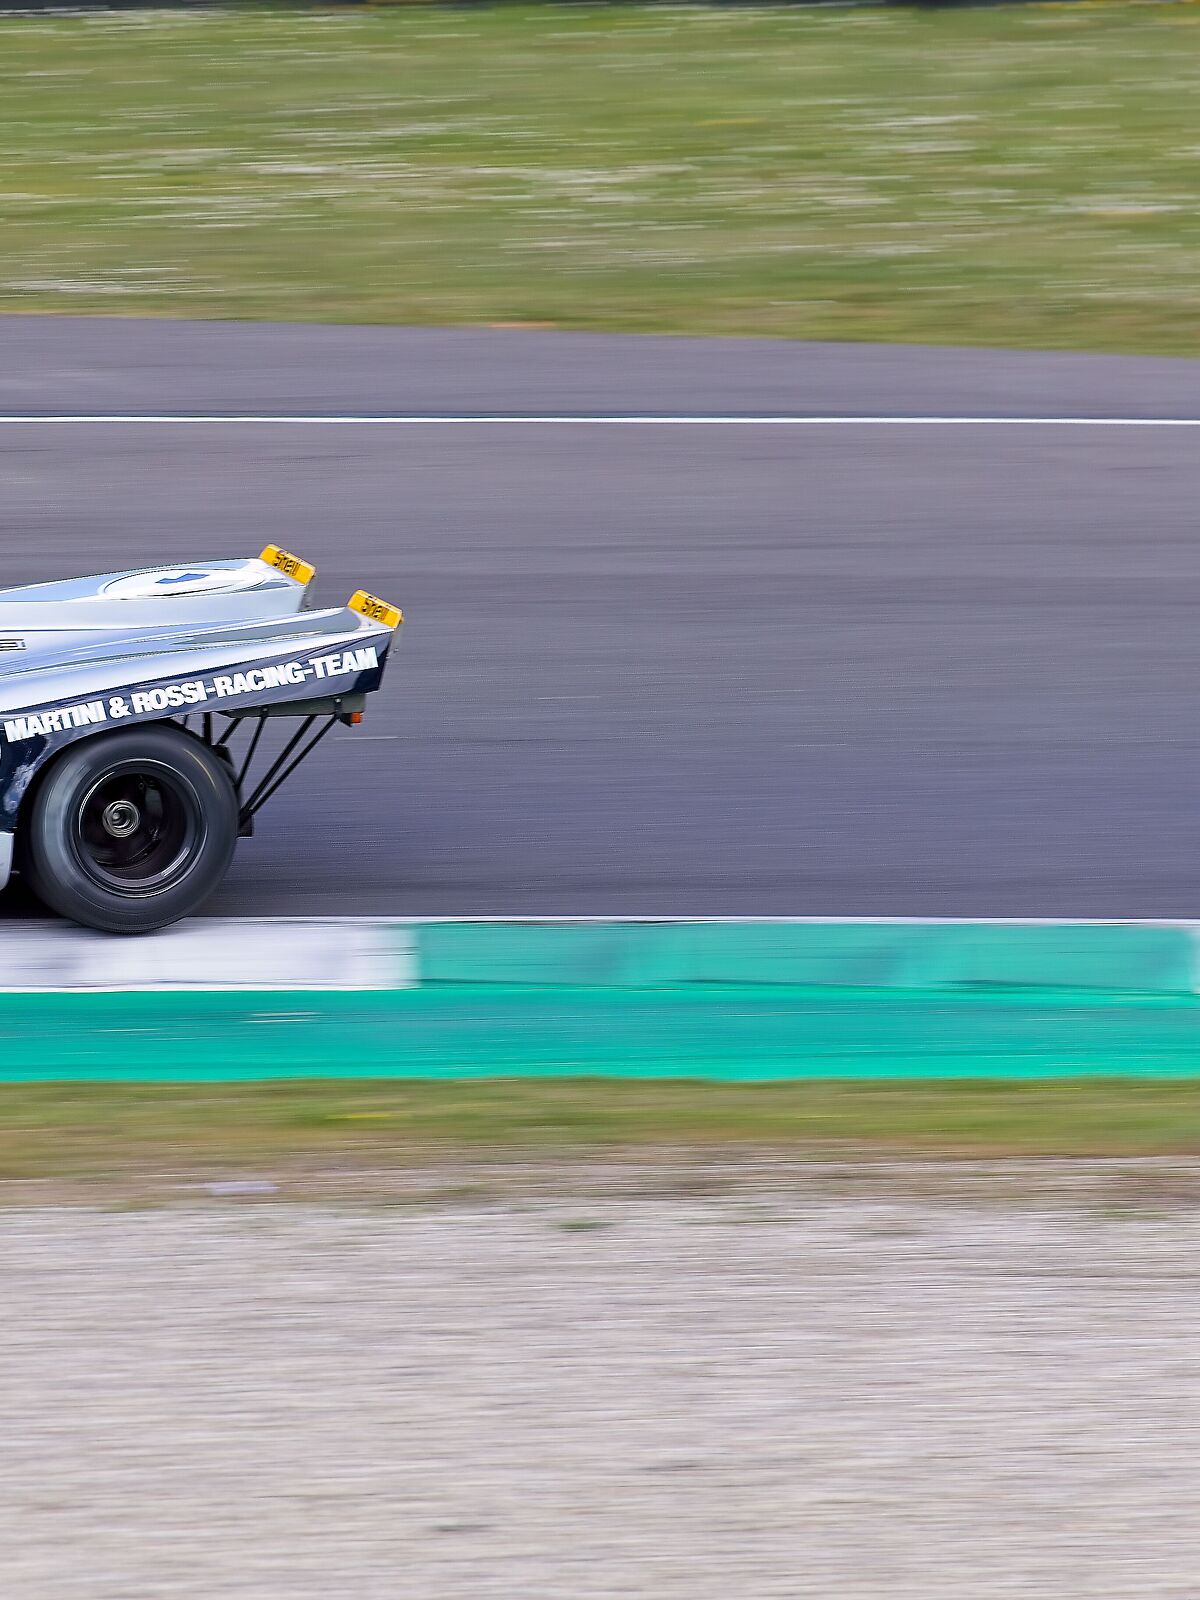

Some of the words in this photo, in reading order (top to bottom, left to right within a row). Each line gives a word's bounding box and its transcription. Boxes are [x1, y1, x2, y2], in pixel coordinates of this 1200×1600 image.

[3, 700, 107, 743] MARTINI
[109, 696, 132, 719] &
[133, 646, 378, 714] ROSSI-RACING-TEAM
